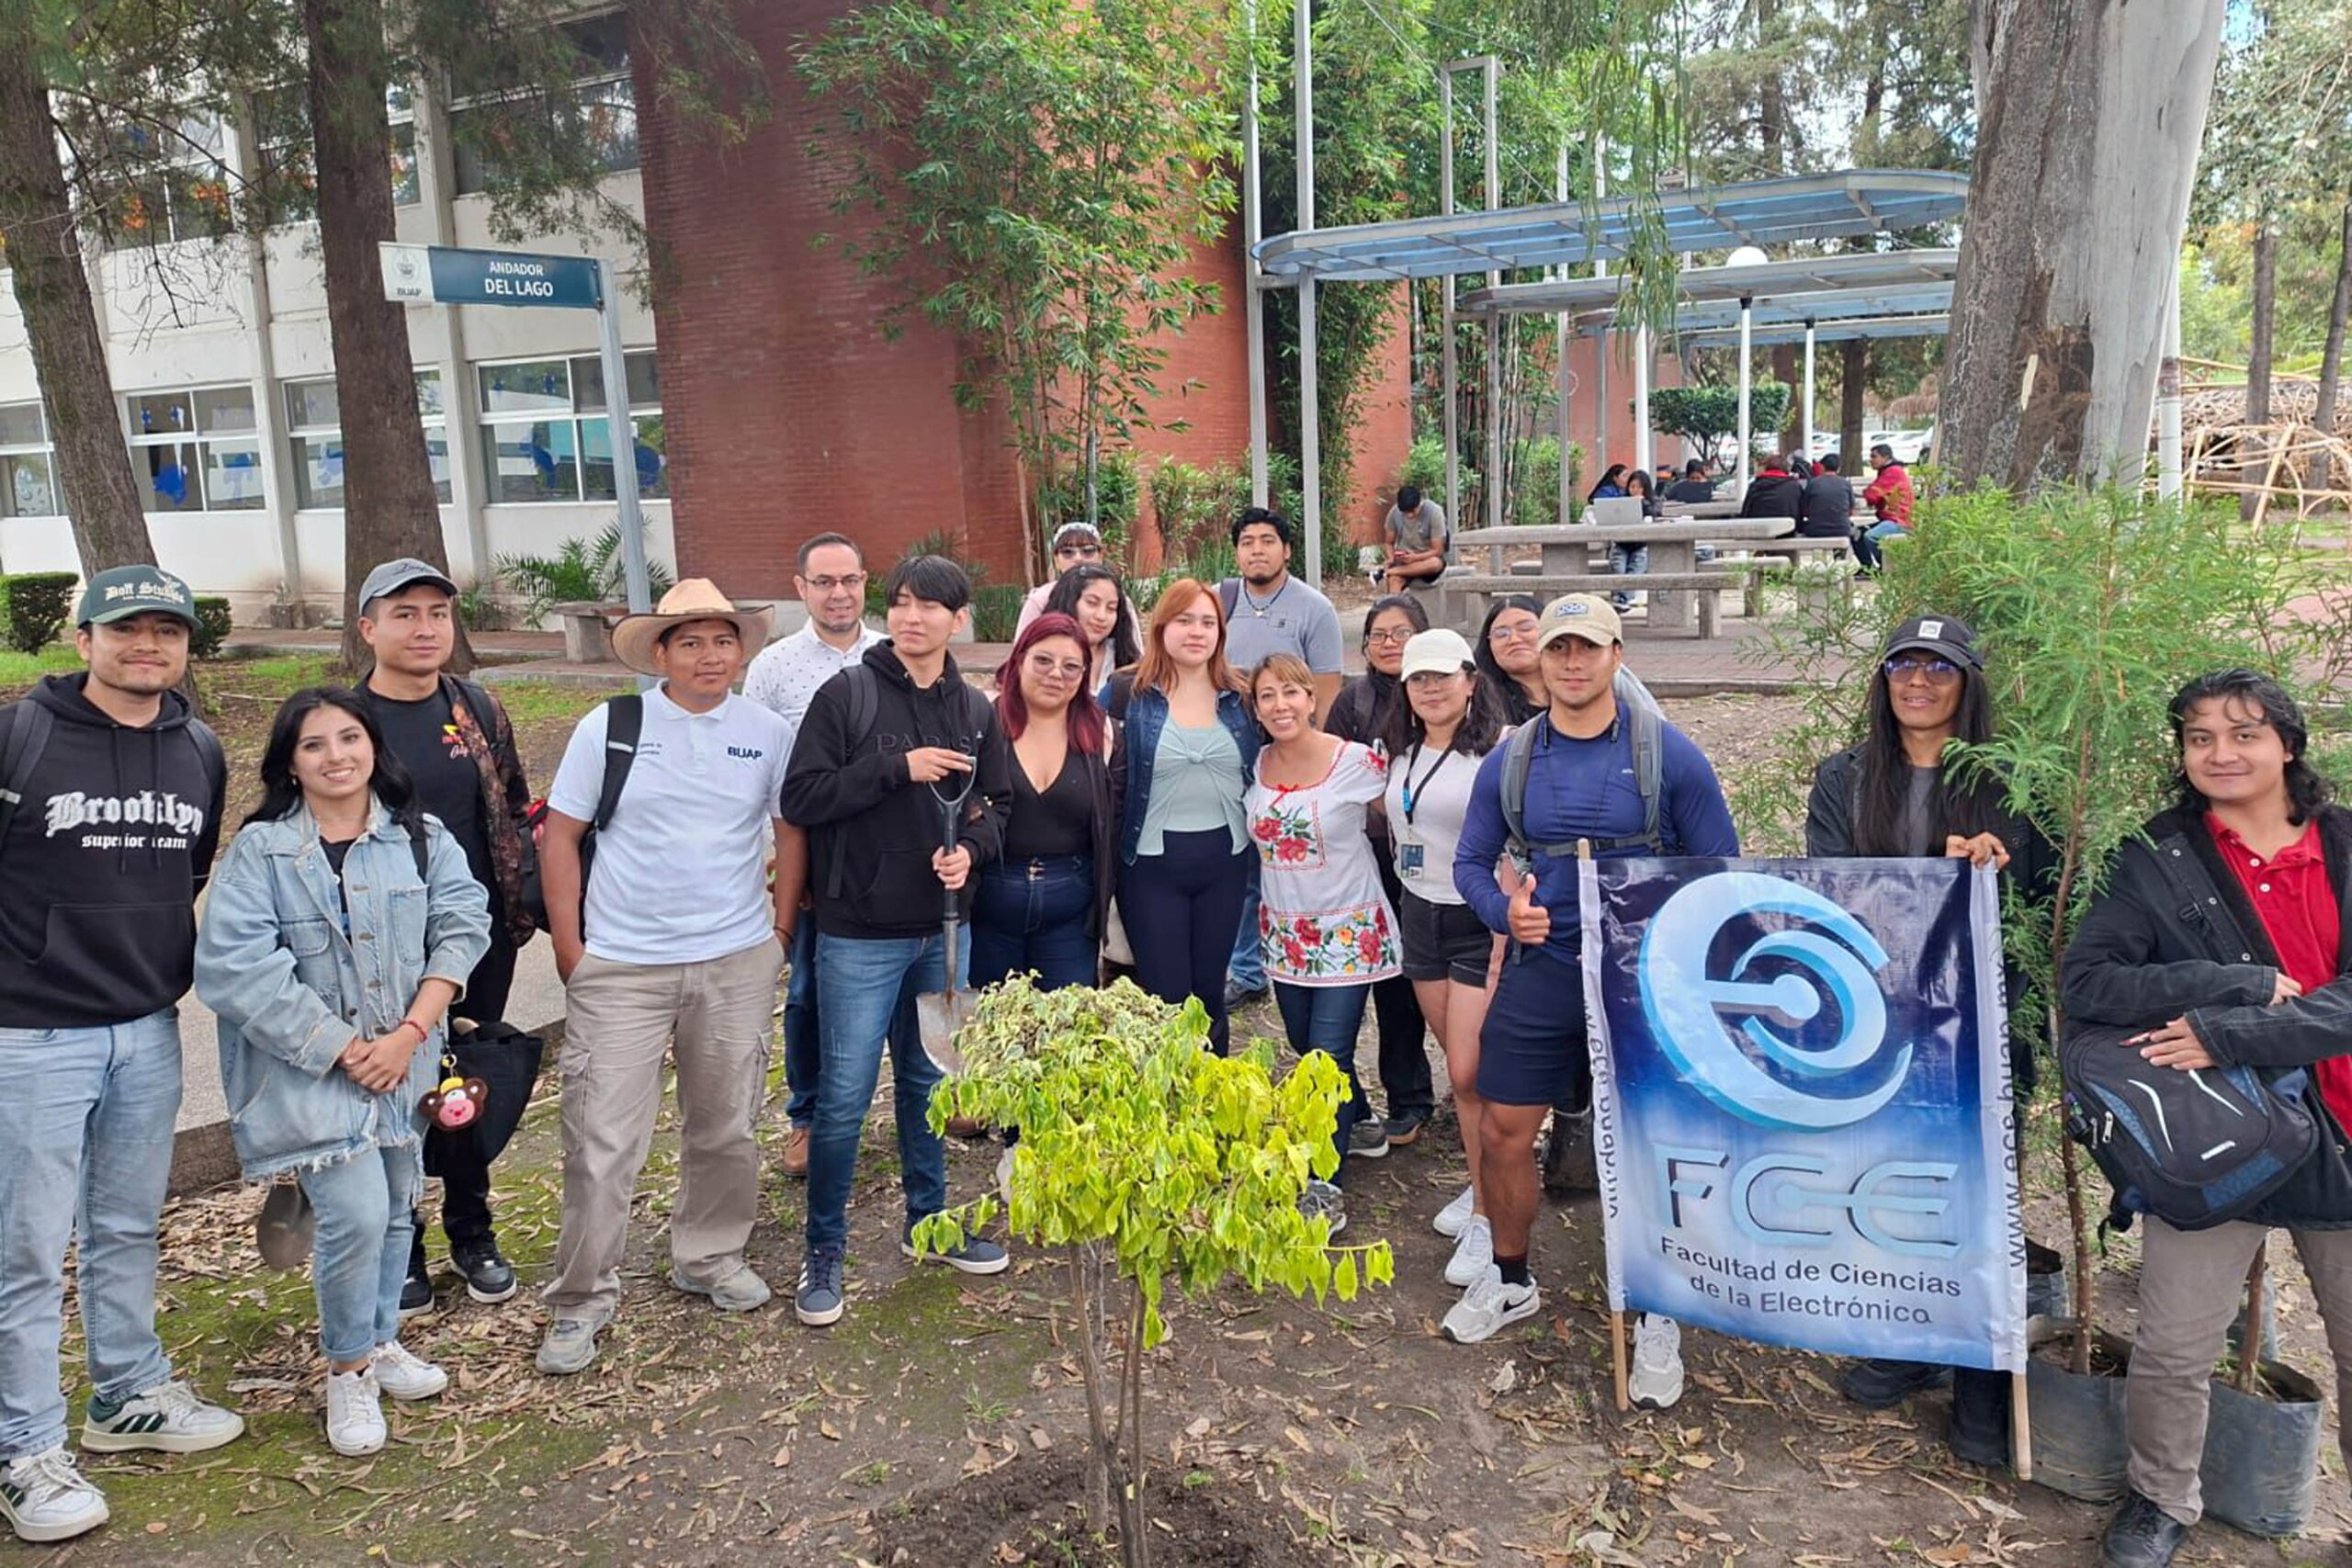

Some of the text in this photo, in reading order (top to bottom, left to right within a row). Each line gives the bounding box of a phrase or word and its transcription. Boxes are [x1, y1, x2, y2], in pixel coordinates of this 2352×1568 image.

[489, 261, 544, 276] ANDADOR
[485, 278, 554, 297] DEL LAGO
[728, 746, 763, 761] BUAP
[876, 733, 973, 755] PARS
[45, 790, 204, 838] Brooklyn
[1660, 1235, 1962, 1297] Facultad de Ciencias
[1690, 1274, 1720, 1298] de
[1728, 1285, 1751, 1309] la
